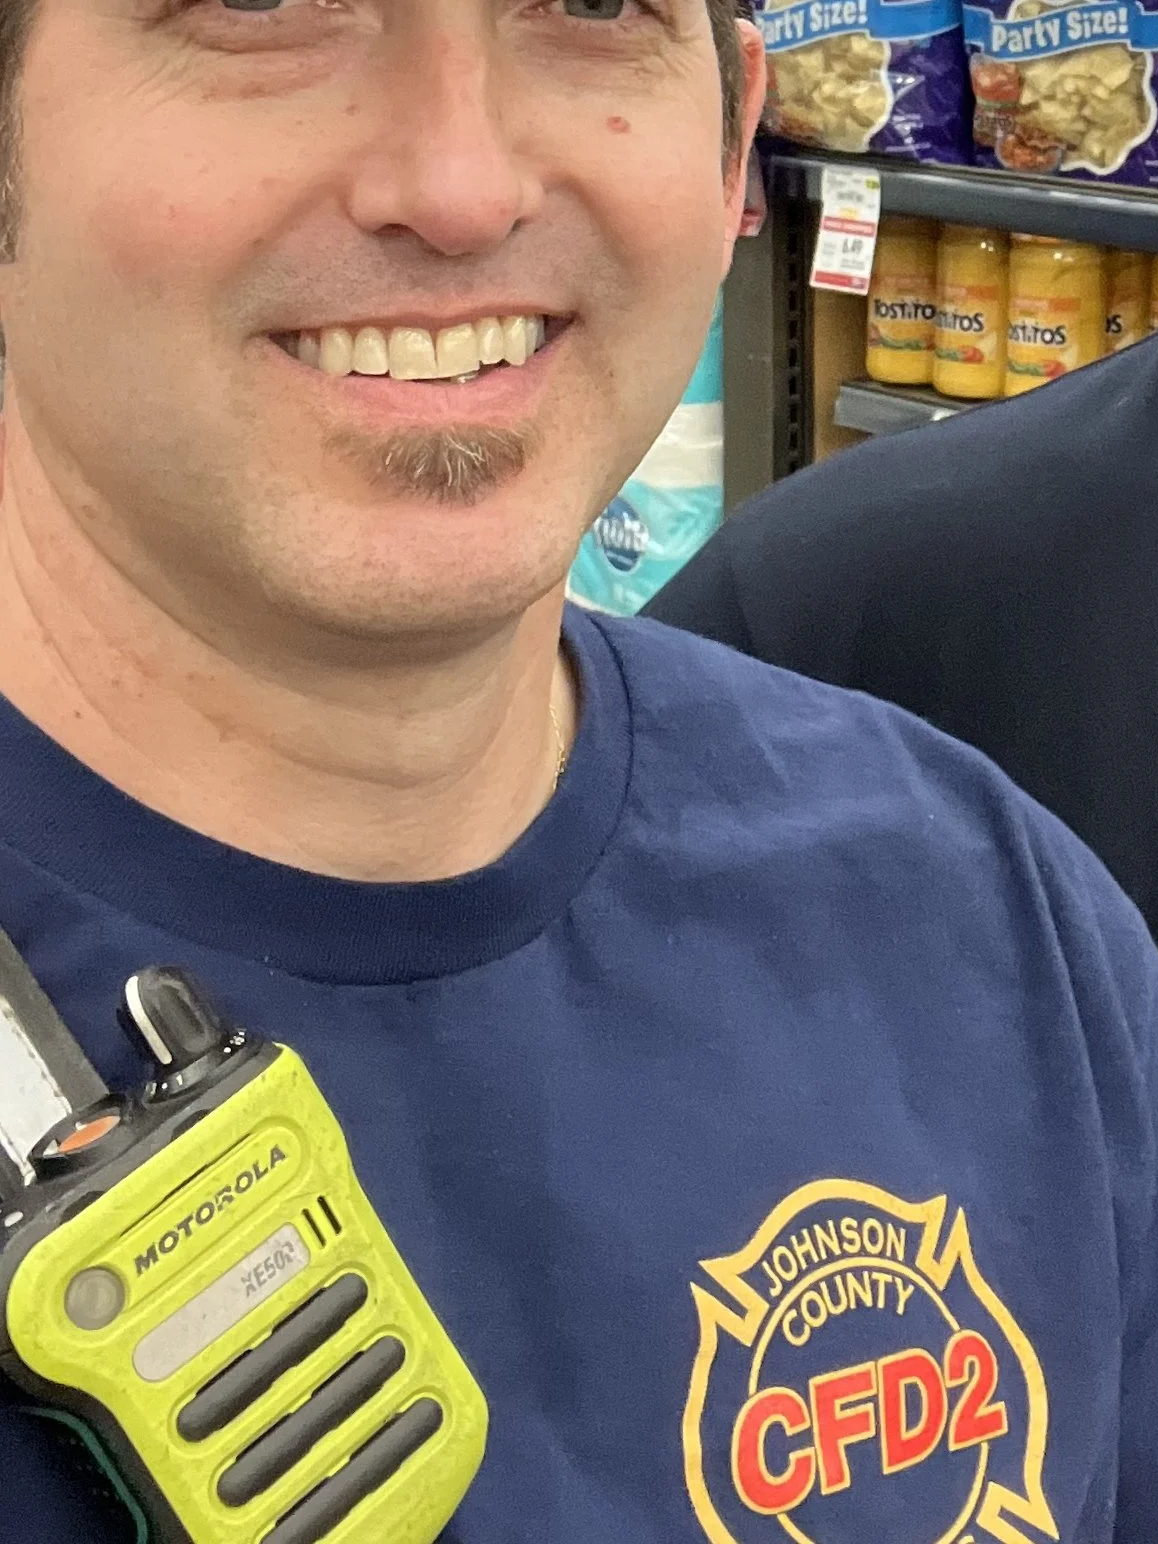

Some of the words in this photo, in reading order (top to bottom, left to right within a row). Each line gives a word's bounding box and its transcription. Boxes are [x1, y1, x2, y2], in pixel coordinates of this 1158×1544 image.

[992, 17, 1061, 53] Party
[1066, 7, 1128, 41] Size!
[133, 1144, 287, 1278] MOTOROLA
[761, 1216, 907, 1298] JOHNSON
[781, 1270, 915, 1347] COUNTY
[730, 1329, 1009, 1516] CFD2
